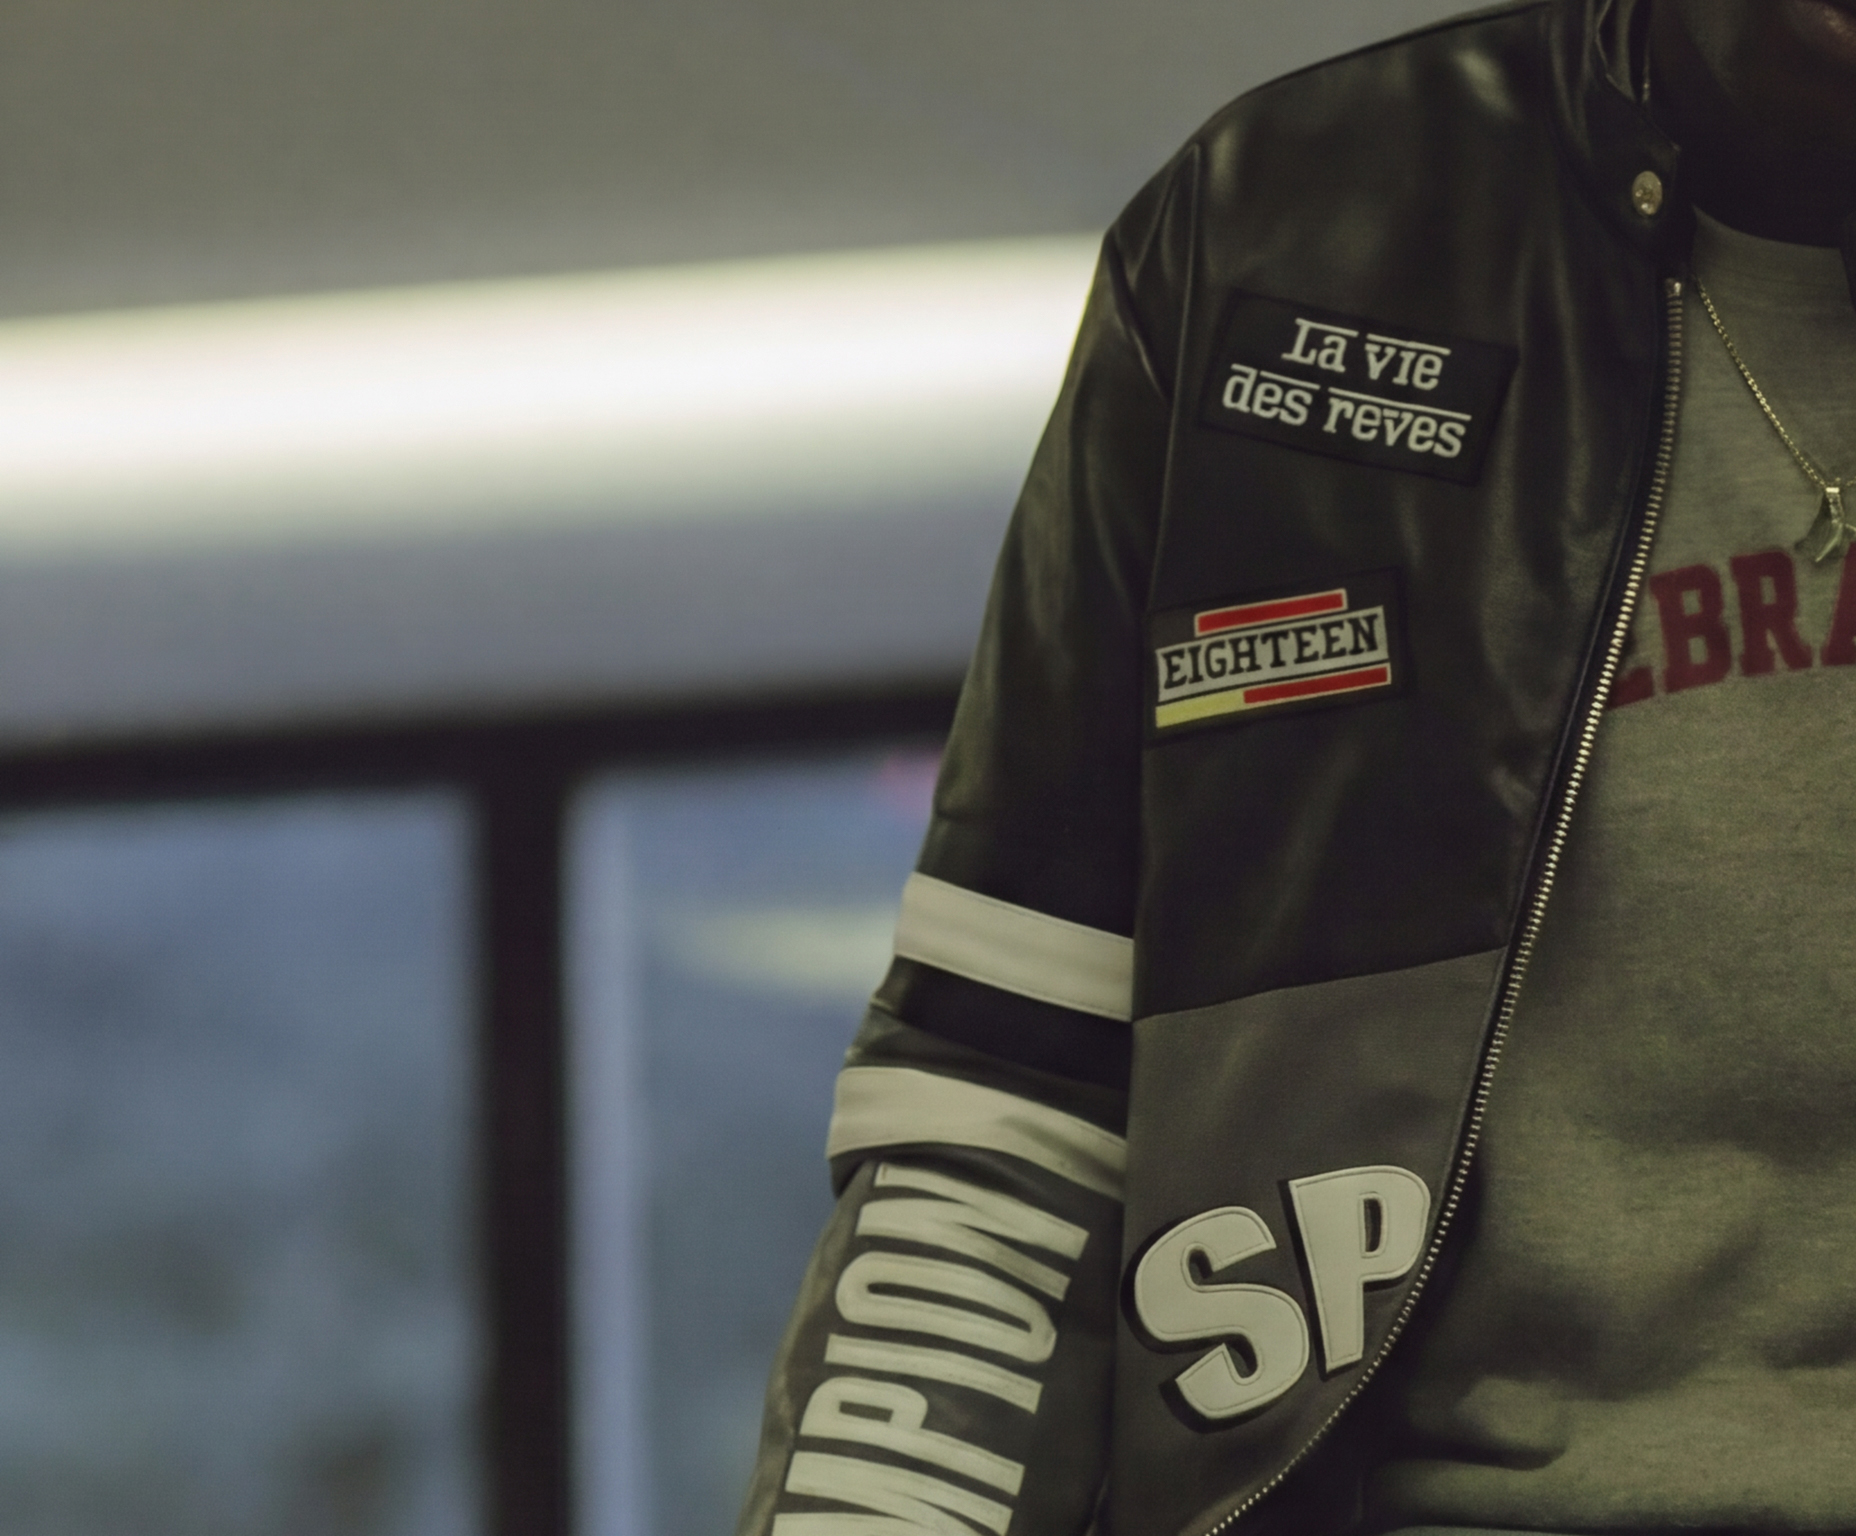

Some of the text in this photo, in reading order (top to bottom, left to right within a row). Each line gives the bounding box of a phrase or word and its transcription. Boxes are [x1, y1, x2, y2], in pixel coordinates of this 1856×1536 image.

[1221, 362, 1322, 426] des
[1160, 613, 1380, 691] EIGHTEEN
[1130, 1163, 1433, 1424] SP
